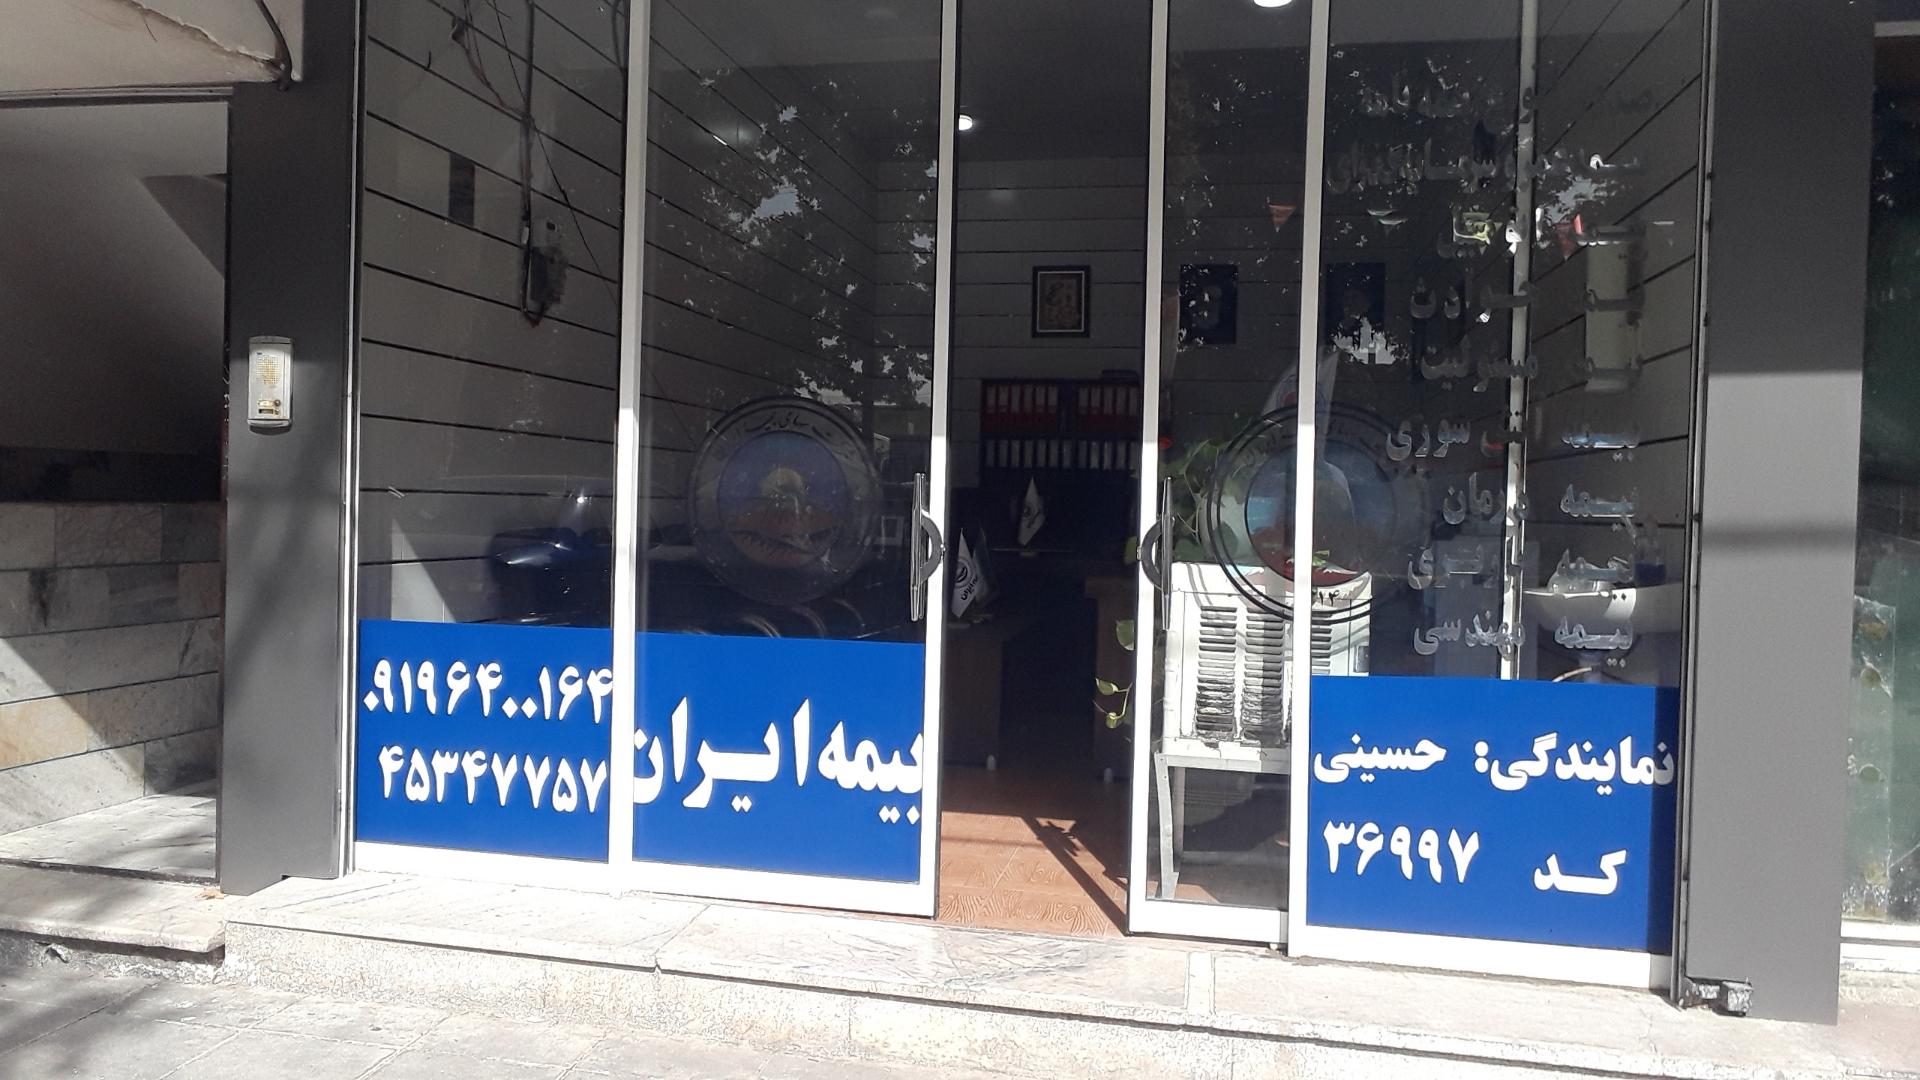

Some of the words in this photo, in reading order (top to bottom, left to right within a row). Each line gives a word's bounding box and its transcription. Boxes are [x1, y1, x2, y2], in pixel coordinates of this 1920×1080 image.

[1413, 610, 1526, 661] مهندسی
[1555, 616, 1634, 667] بیمه
[363, 659, 613, 724] ۰۹۱۹۶۴۰۰۱۶۴
[378, 745, 608, 813] ۴۵۳۴۷۷۵۷
[633, 696, 811, 812] ایران
[817, 720, 925, 825] بیمه
[1313, 733, 1448, 784] حسینی
[1474, 732, 1675, 796] نمایندگی:
[1323, 820, 1480, 884] ۳۶۹۹۷
[1533, 850, 1628, 896] کد
